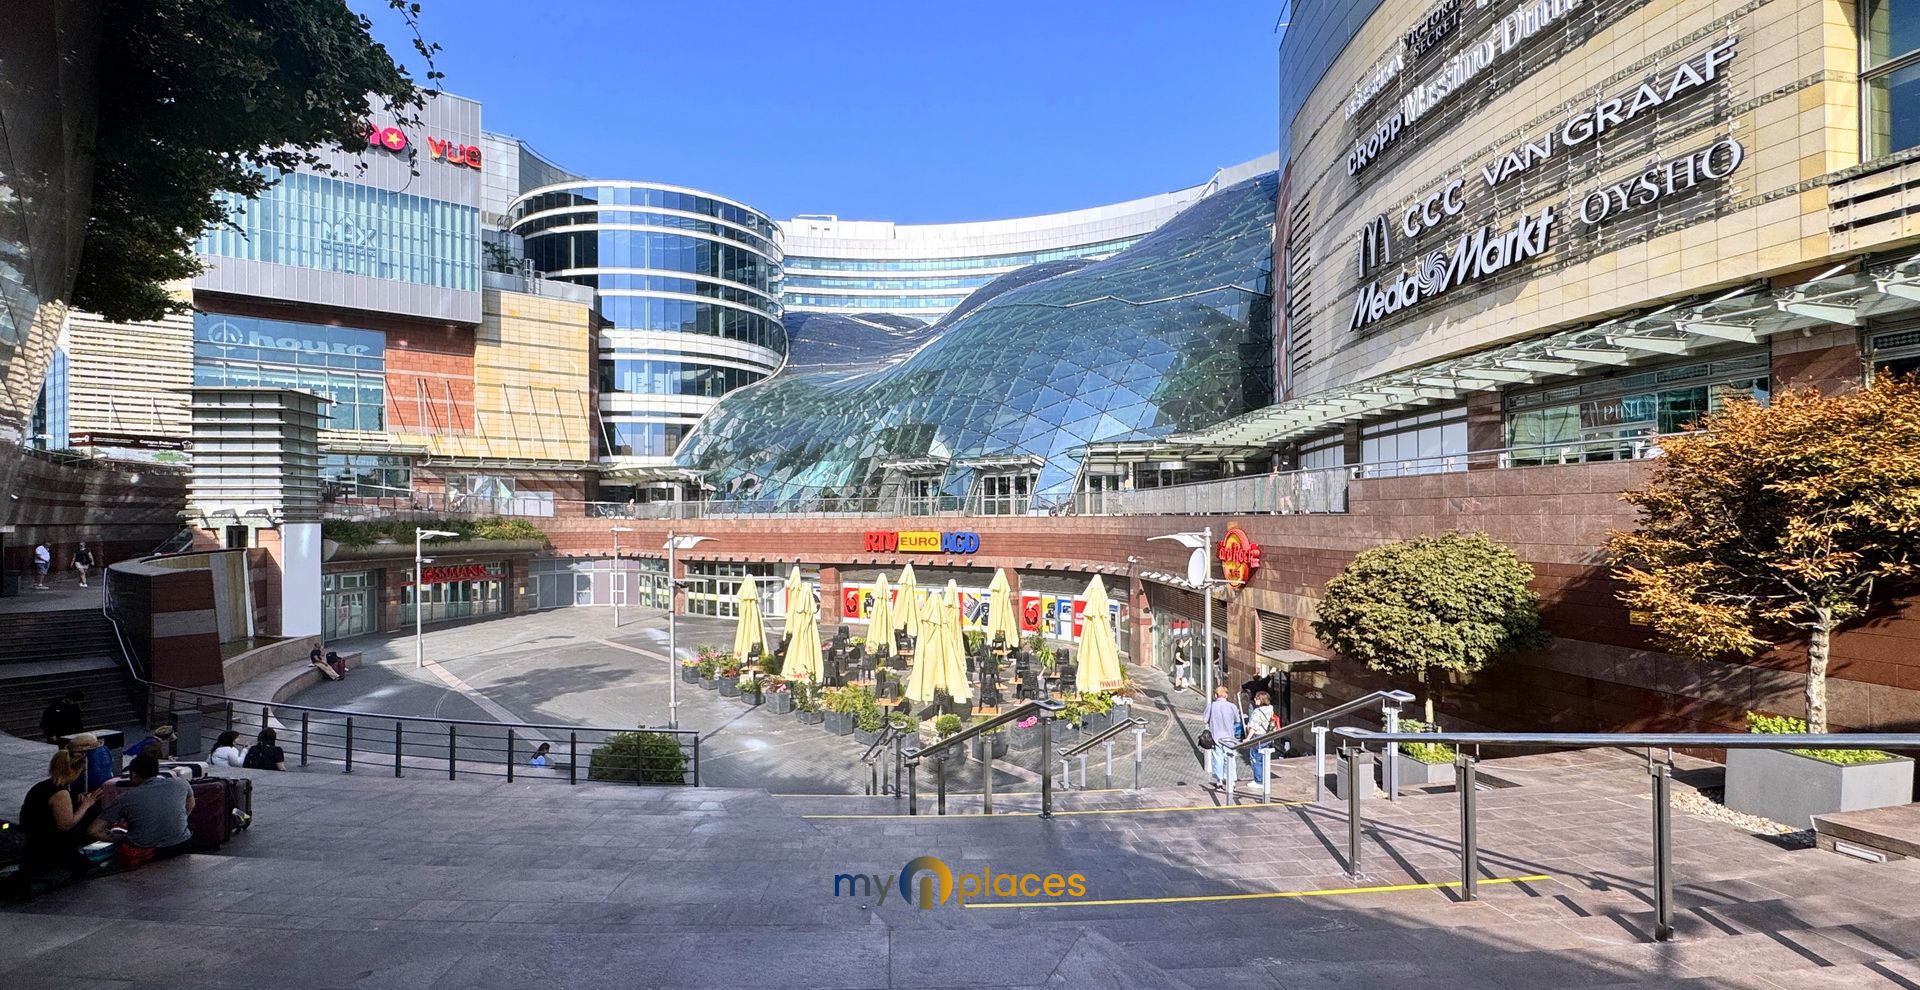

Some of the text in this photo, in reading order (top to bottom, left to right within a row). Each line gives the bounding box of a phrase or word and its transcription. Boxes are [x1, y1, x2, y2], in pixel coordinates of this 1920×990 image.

[1404, 40, 1494, 126] Massimo
[1481, 36, 1739, 187] VAN GRAAF
[1347, 113, 1404, 177] CROPP
[1403, 179, 1465, 238] CCC
[1580, 139, 1744, 225] OYSHO
[420, 565, 487, 582] OSSMANN
[864, 531, 980, 554] RTV EURO AGD
